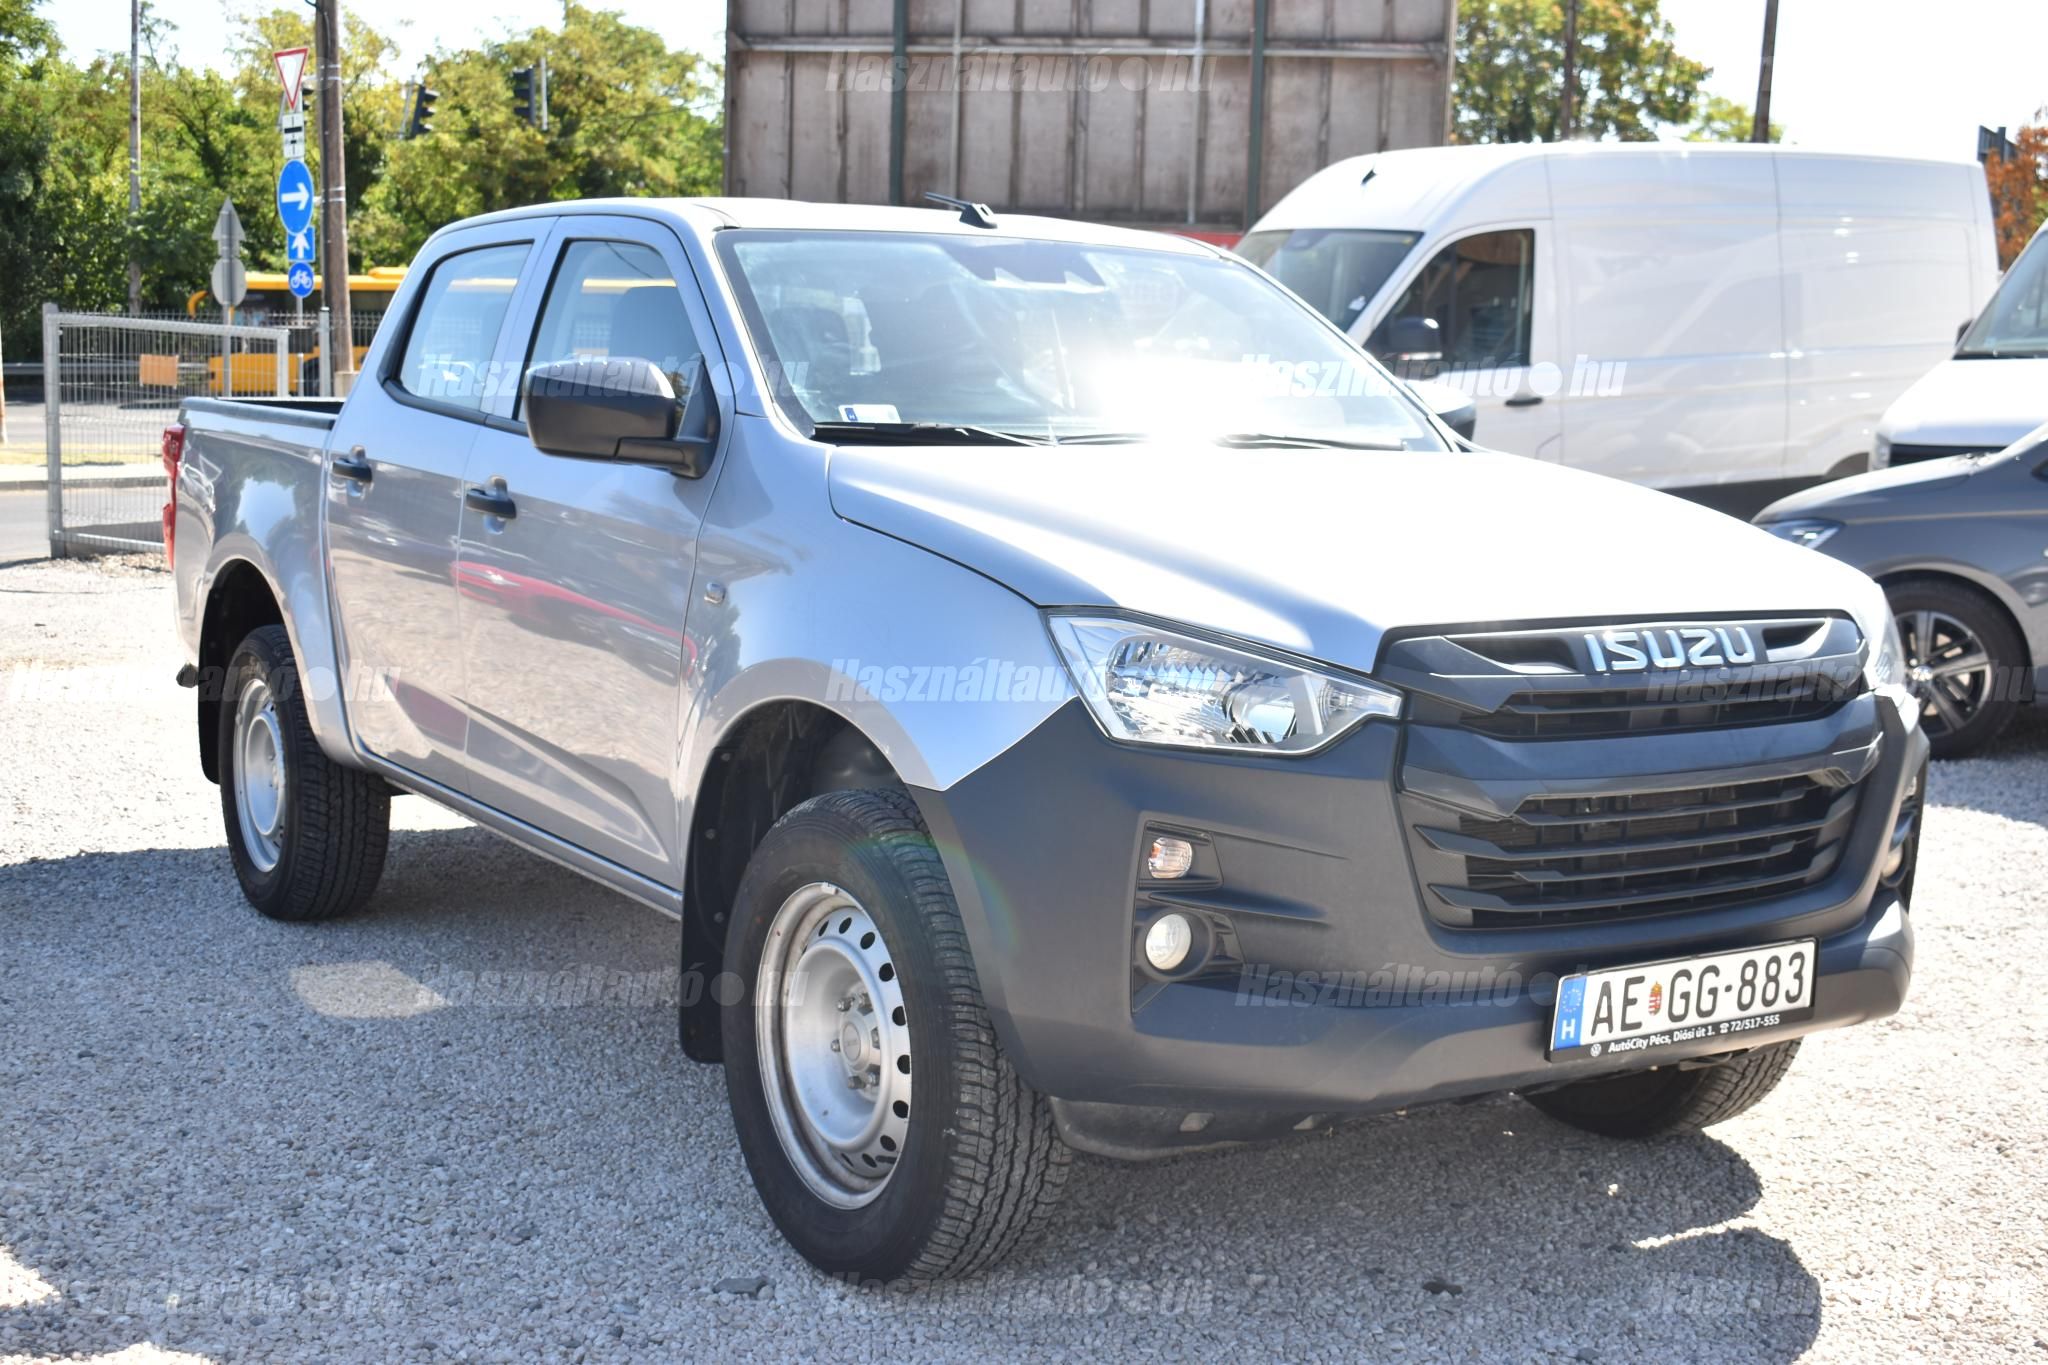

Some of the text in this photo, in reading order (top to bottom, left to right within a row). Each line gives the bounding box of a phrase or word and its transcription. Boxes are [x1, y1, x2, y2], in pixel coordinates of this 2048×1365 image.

[1584, 626, 1756, 672] ISUZU
[1591, 951, 1805, 1036] AE GG-883
[1561, 1018, 1576, 1040] H
[1608, 1037, 1648, 1053] AutóCity
[1730, 1014, 1780, 1032] 72/517-555
